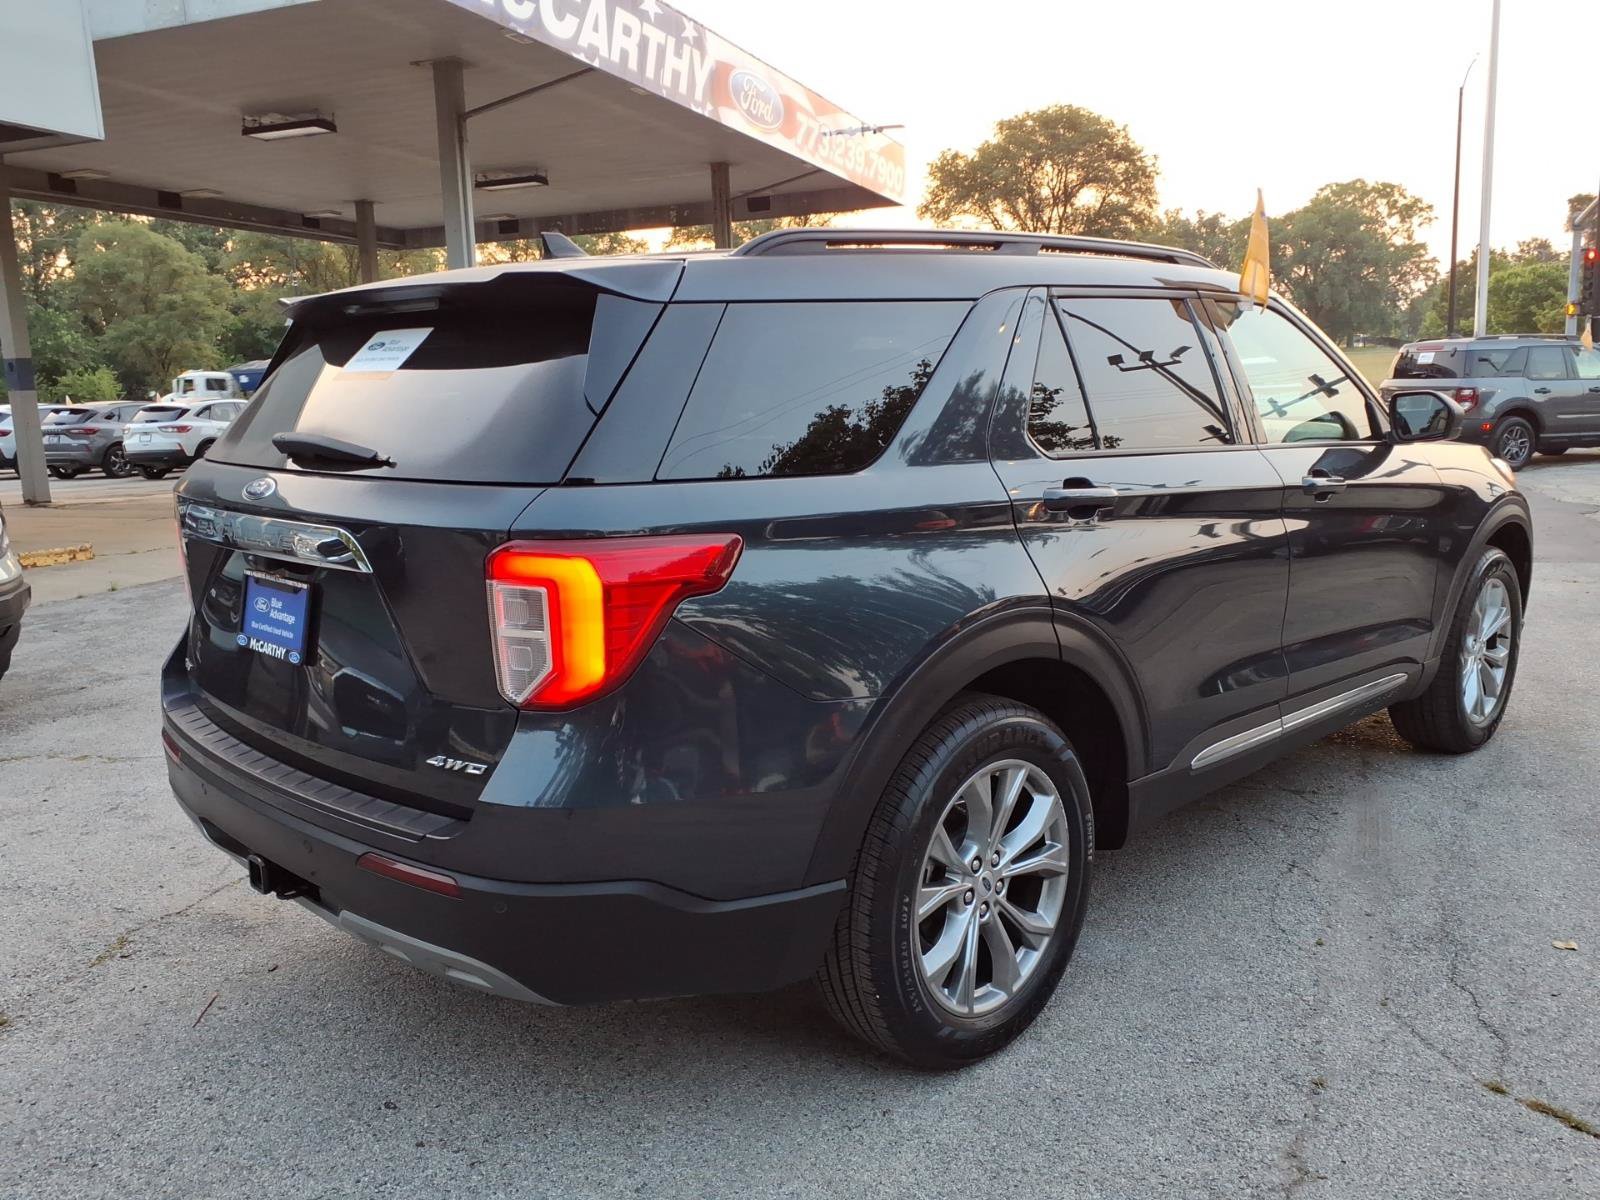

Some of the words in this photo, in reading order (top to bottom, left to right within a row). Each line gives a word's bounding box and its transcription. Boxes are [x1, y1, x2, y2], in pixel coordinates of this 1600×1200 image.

[482, 0, 716, 101] CARTHY
[740, 75, 774, 124] Ford
[271, 597, 282, 608] Blue
[270, 608, 296, 625] Advantage
[249, 637, 287, 660] McCARTHY
[425, 755, 488, 775] 4WD
